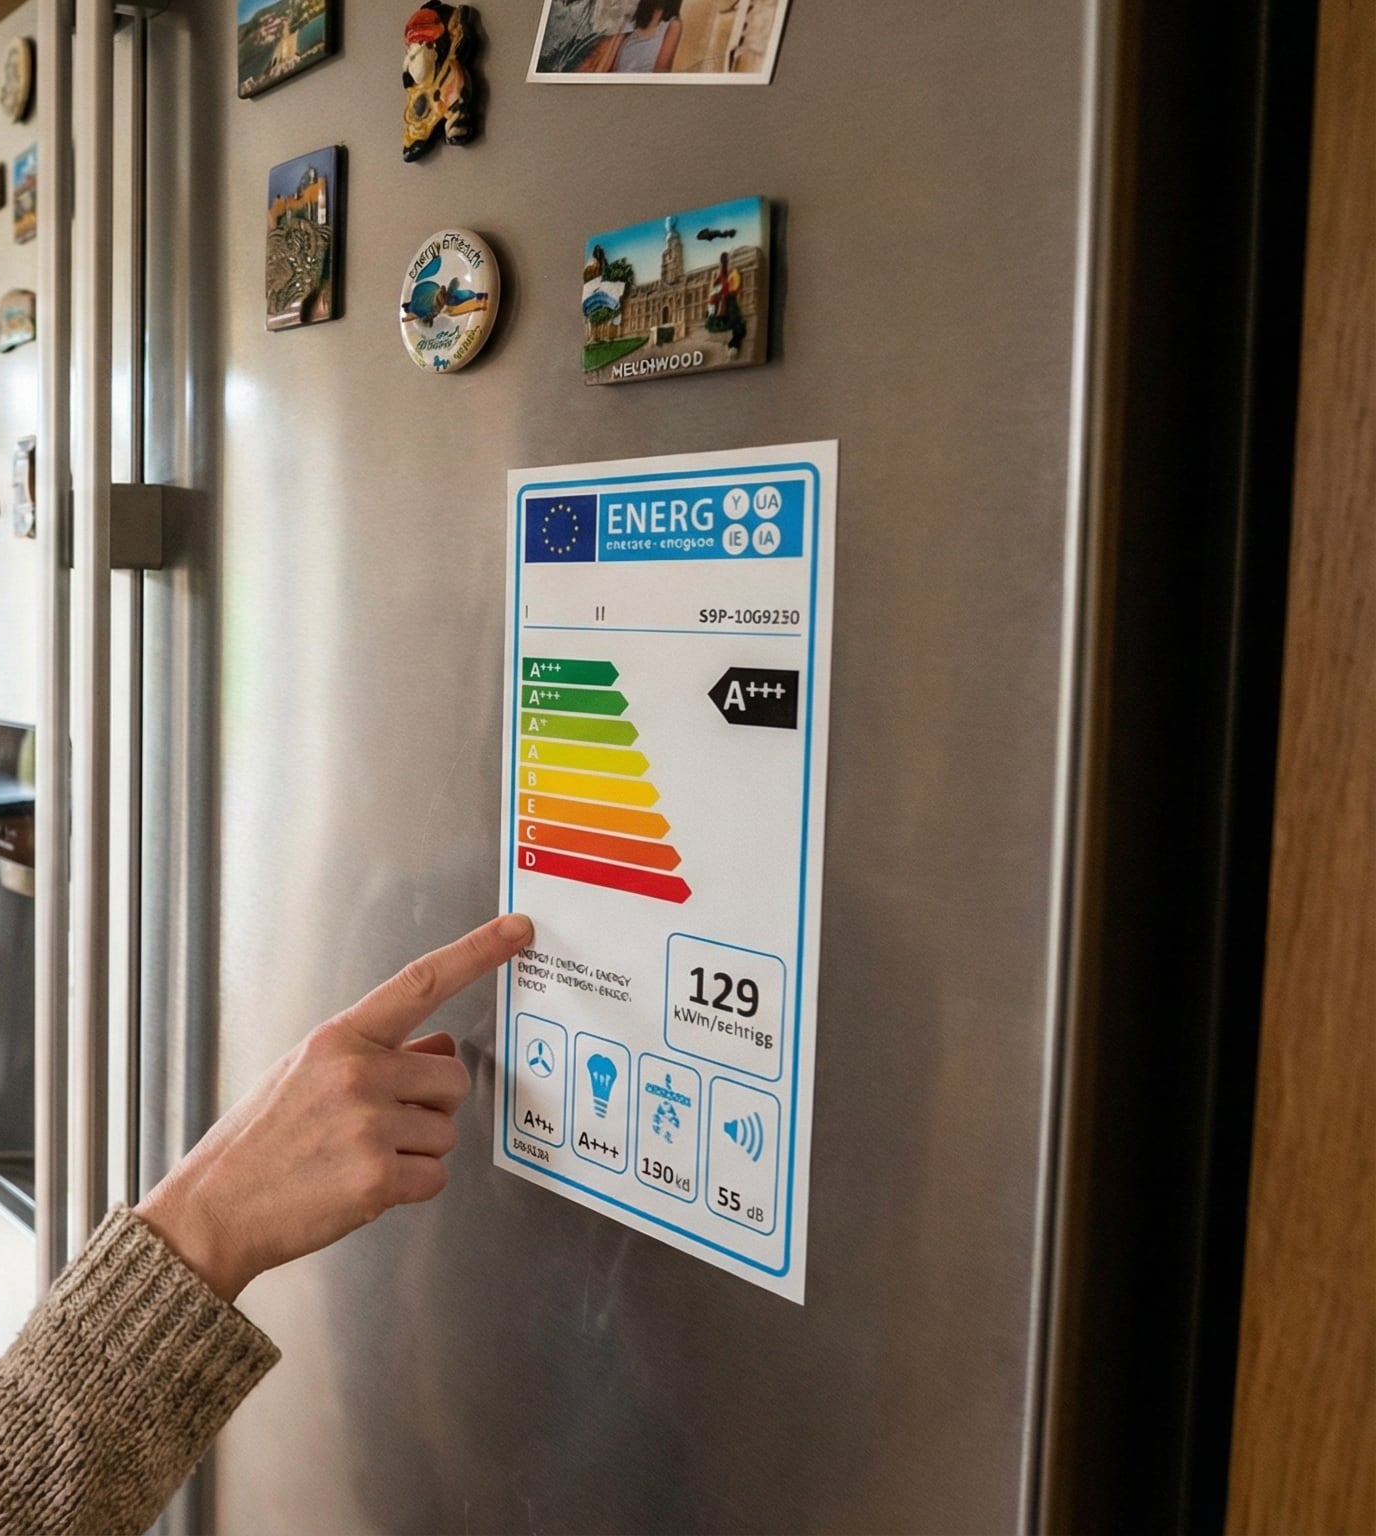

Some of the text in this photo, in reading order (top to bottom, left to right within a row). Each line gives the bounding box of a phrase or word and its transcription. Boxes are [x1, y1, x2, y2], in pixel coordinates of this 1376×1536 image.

[732, 495, 741, 511] Y
[756, 494, 779, 511] UA
[608, 498, 714, 535] ENERG
[723, 680, 787, 712] A+++
[527, 745, 539, 760] A
[527, 772, 538, 787] B
[527, 798, 536, 814] E
[526, 825, 537, 841] C
[525, 851, 536, 868] D
[689, 966, 760, 1018] 129
[578, 1131, 620, 1159] A+++
[717, 1186, 765, 1223] 55 dB
